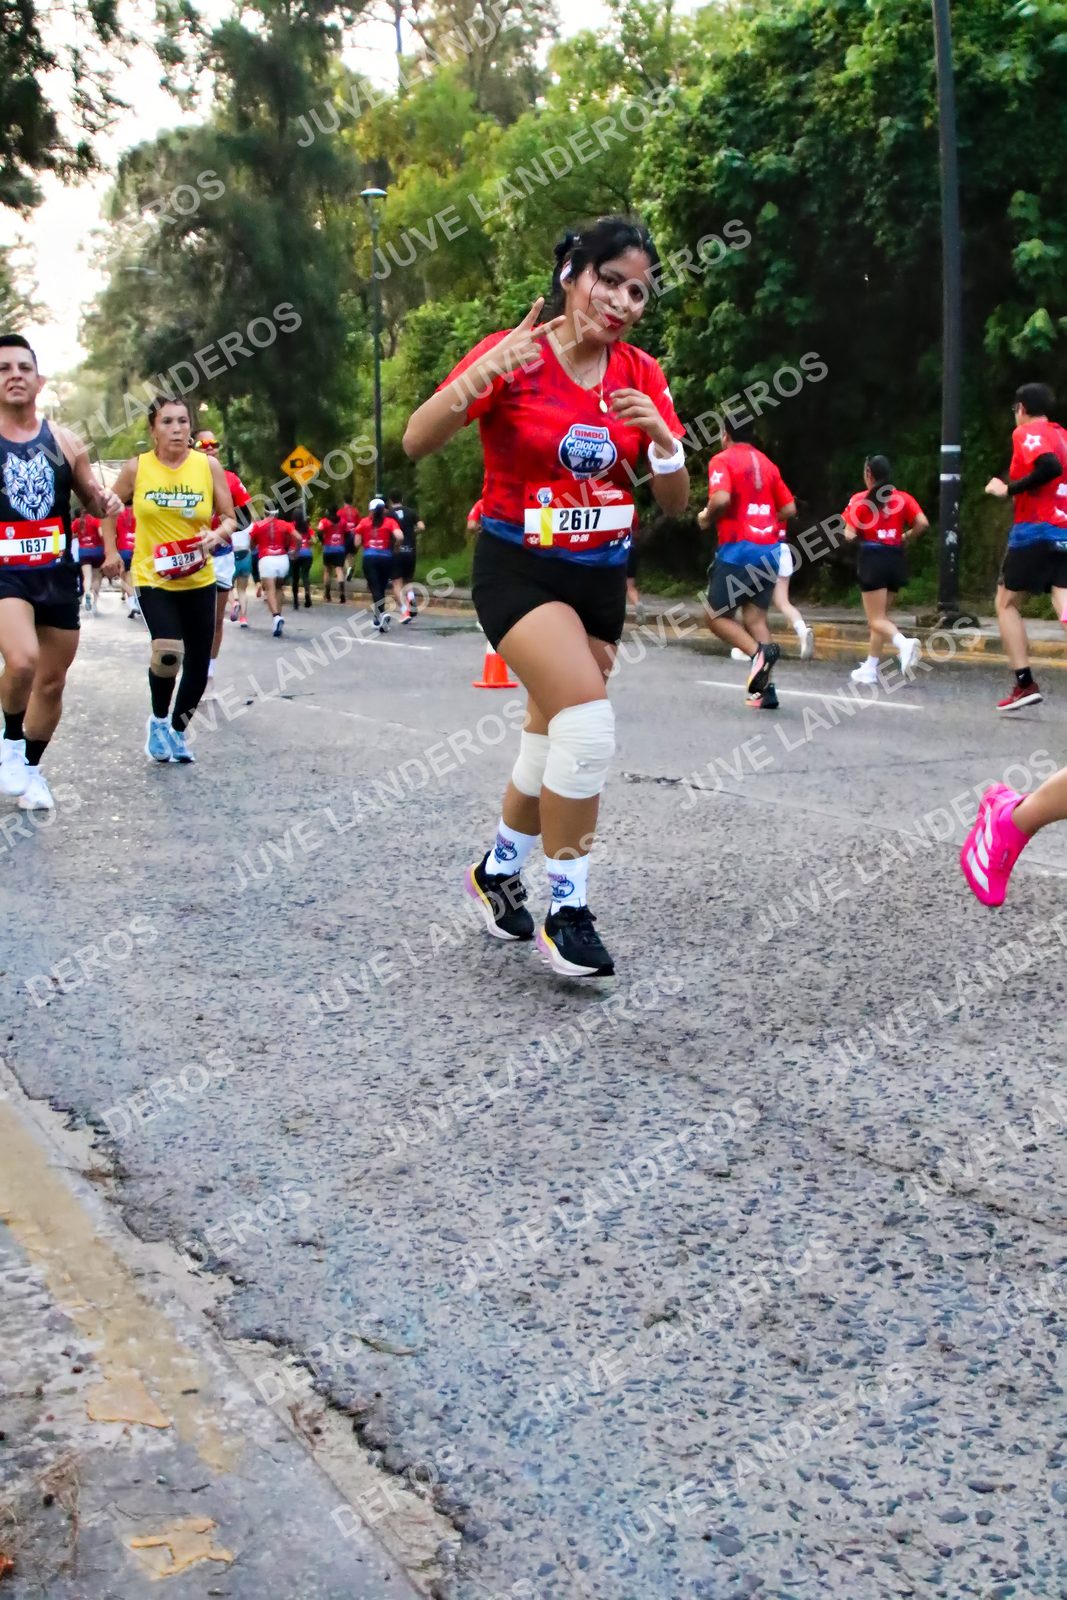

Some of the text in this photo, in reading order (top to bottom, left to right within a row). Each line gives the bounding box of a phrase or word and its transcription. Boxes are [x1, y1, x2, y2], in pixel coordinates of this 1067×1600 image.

[574, 430, 604, 439] BIMBO
[574, 440, 604, 452] Global
[559, 508, 601, 531] 2617
[20, 538, 47, 554] 1637
[171, 552, 196, 567] 3328
